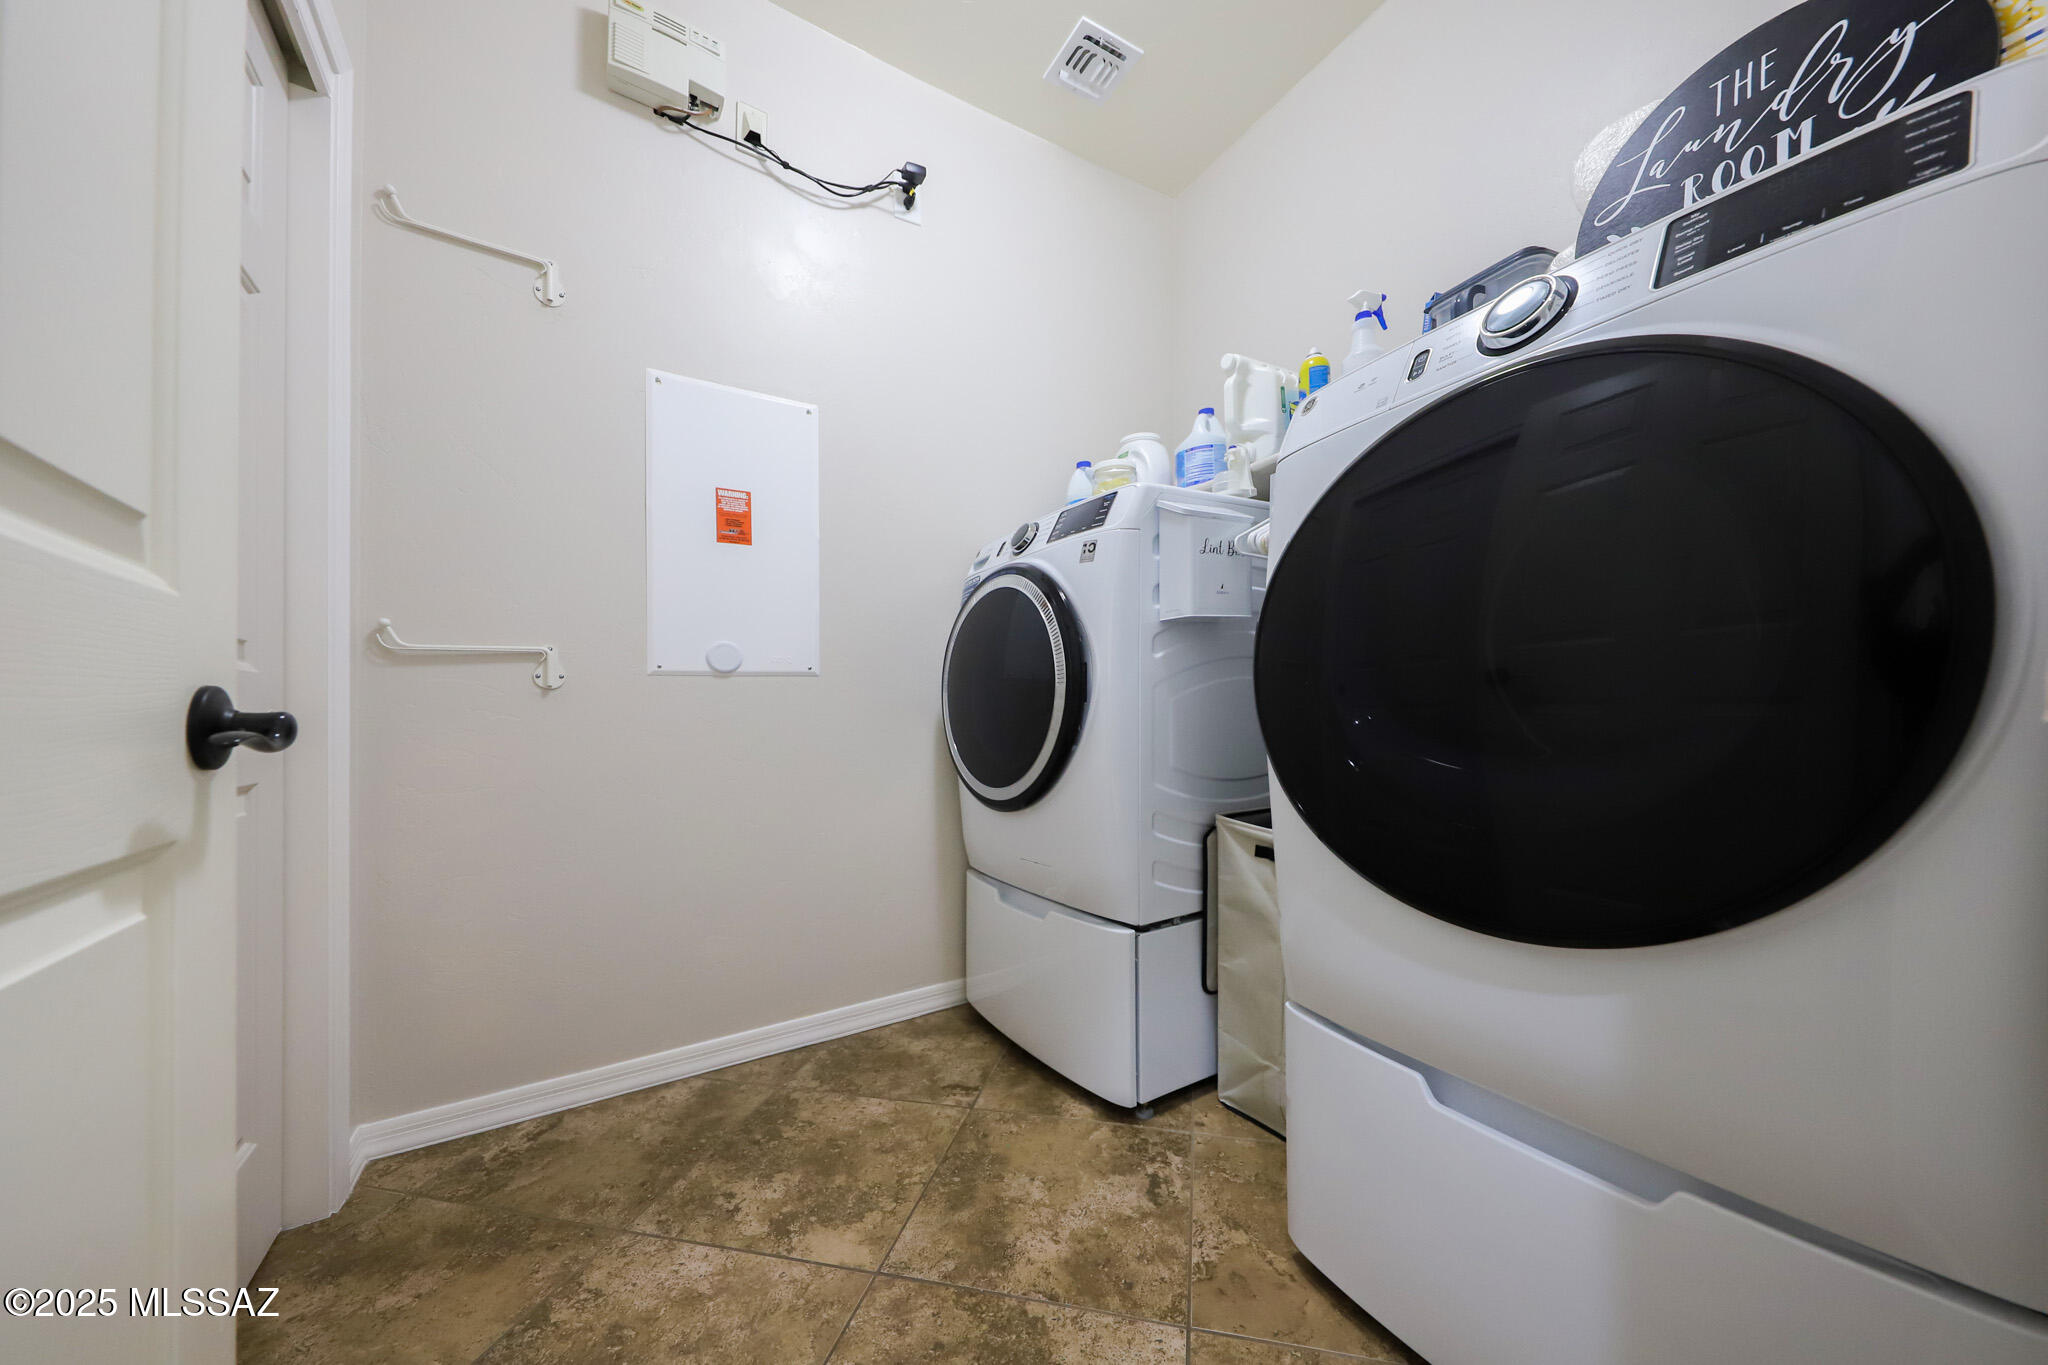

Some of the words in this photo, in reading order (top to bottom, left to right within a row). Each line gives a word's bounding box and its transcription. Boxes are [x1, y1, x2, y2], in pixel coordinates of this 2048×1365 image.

[1593, 0, 1955, 228] Laundry
[1709, 47, 1779, 117] THE
[1679, 115, 1818, 209] ROOM
[1199, 537, 1224, 555] Lint
